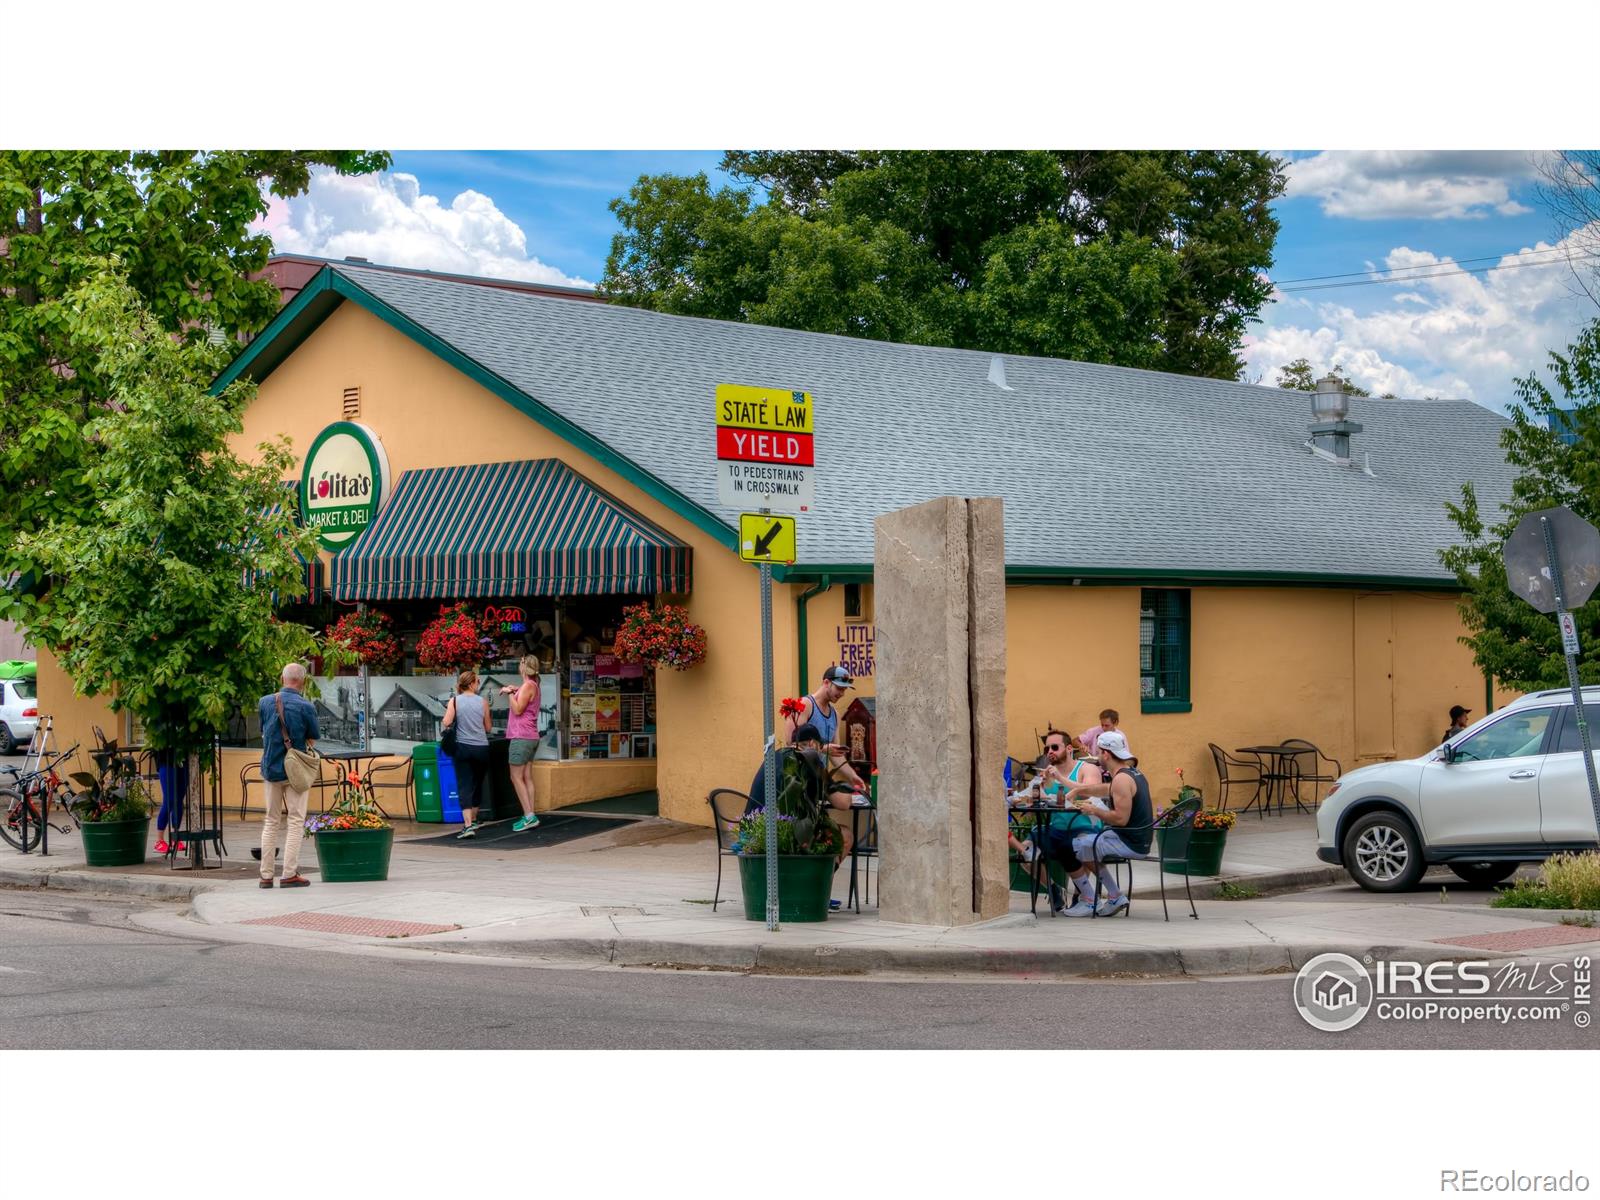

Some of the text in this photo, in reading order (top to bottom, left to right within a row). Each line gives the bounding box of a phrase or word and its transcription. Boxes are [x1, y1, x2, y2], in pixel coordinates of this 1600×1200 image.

[723, 400, 806, 428] STATE LAW
[733, 432, 800, 459] YIELD
[729, 465, 804, 482] TO PEDESTRIANS
[310, 472, 371, 501] Lolita's
[734, 479, 799, 495] IN CROSSWALK
[308, 509, 369, 527] MARKET & DELI
[841, 644, 874, 661] FREE
